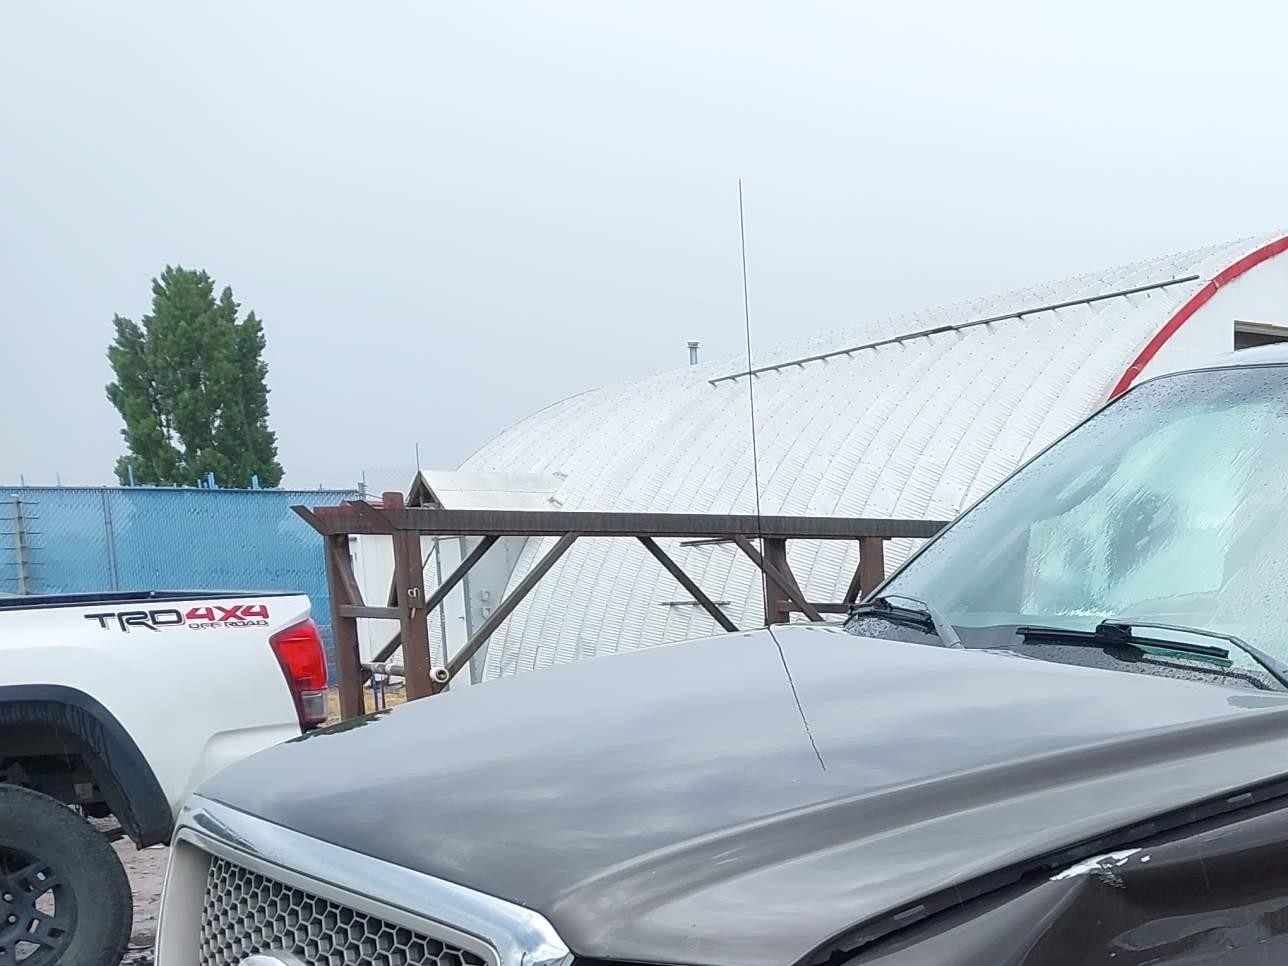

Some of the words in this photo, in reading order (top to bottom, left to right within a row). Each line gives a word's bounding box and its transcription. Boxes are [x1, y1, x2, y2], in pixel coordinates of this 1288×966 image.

[84, 608, 185, 633] TRD
[188, 622, 222, 630] OFF
[224, 620, 270, 628] ROAD
